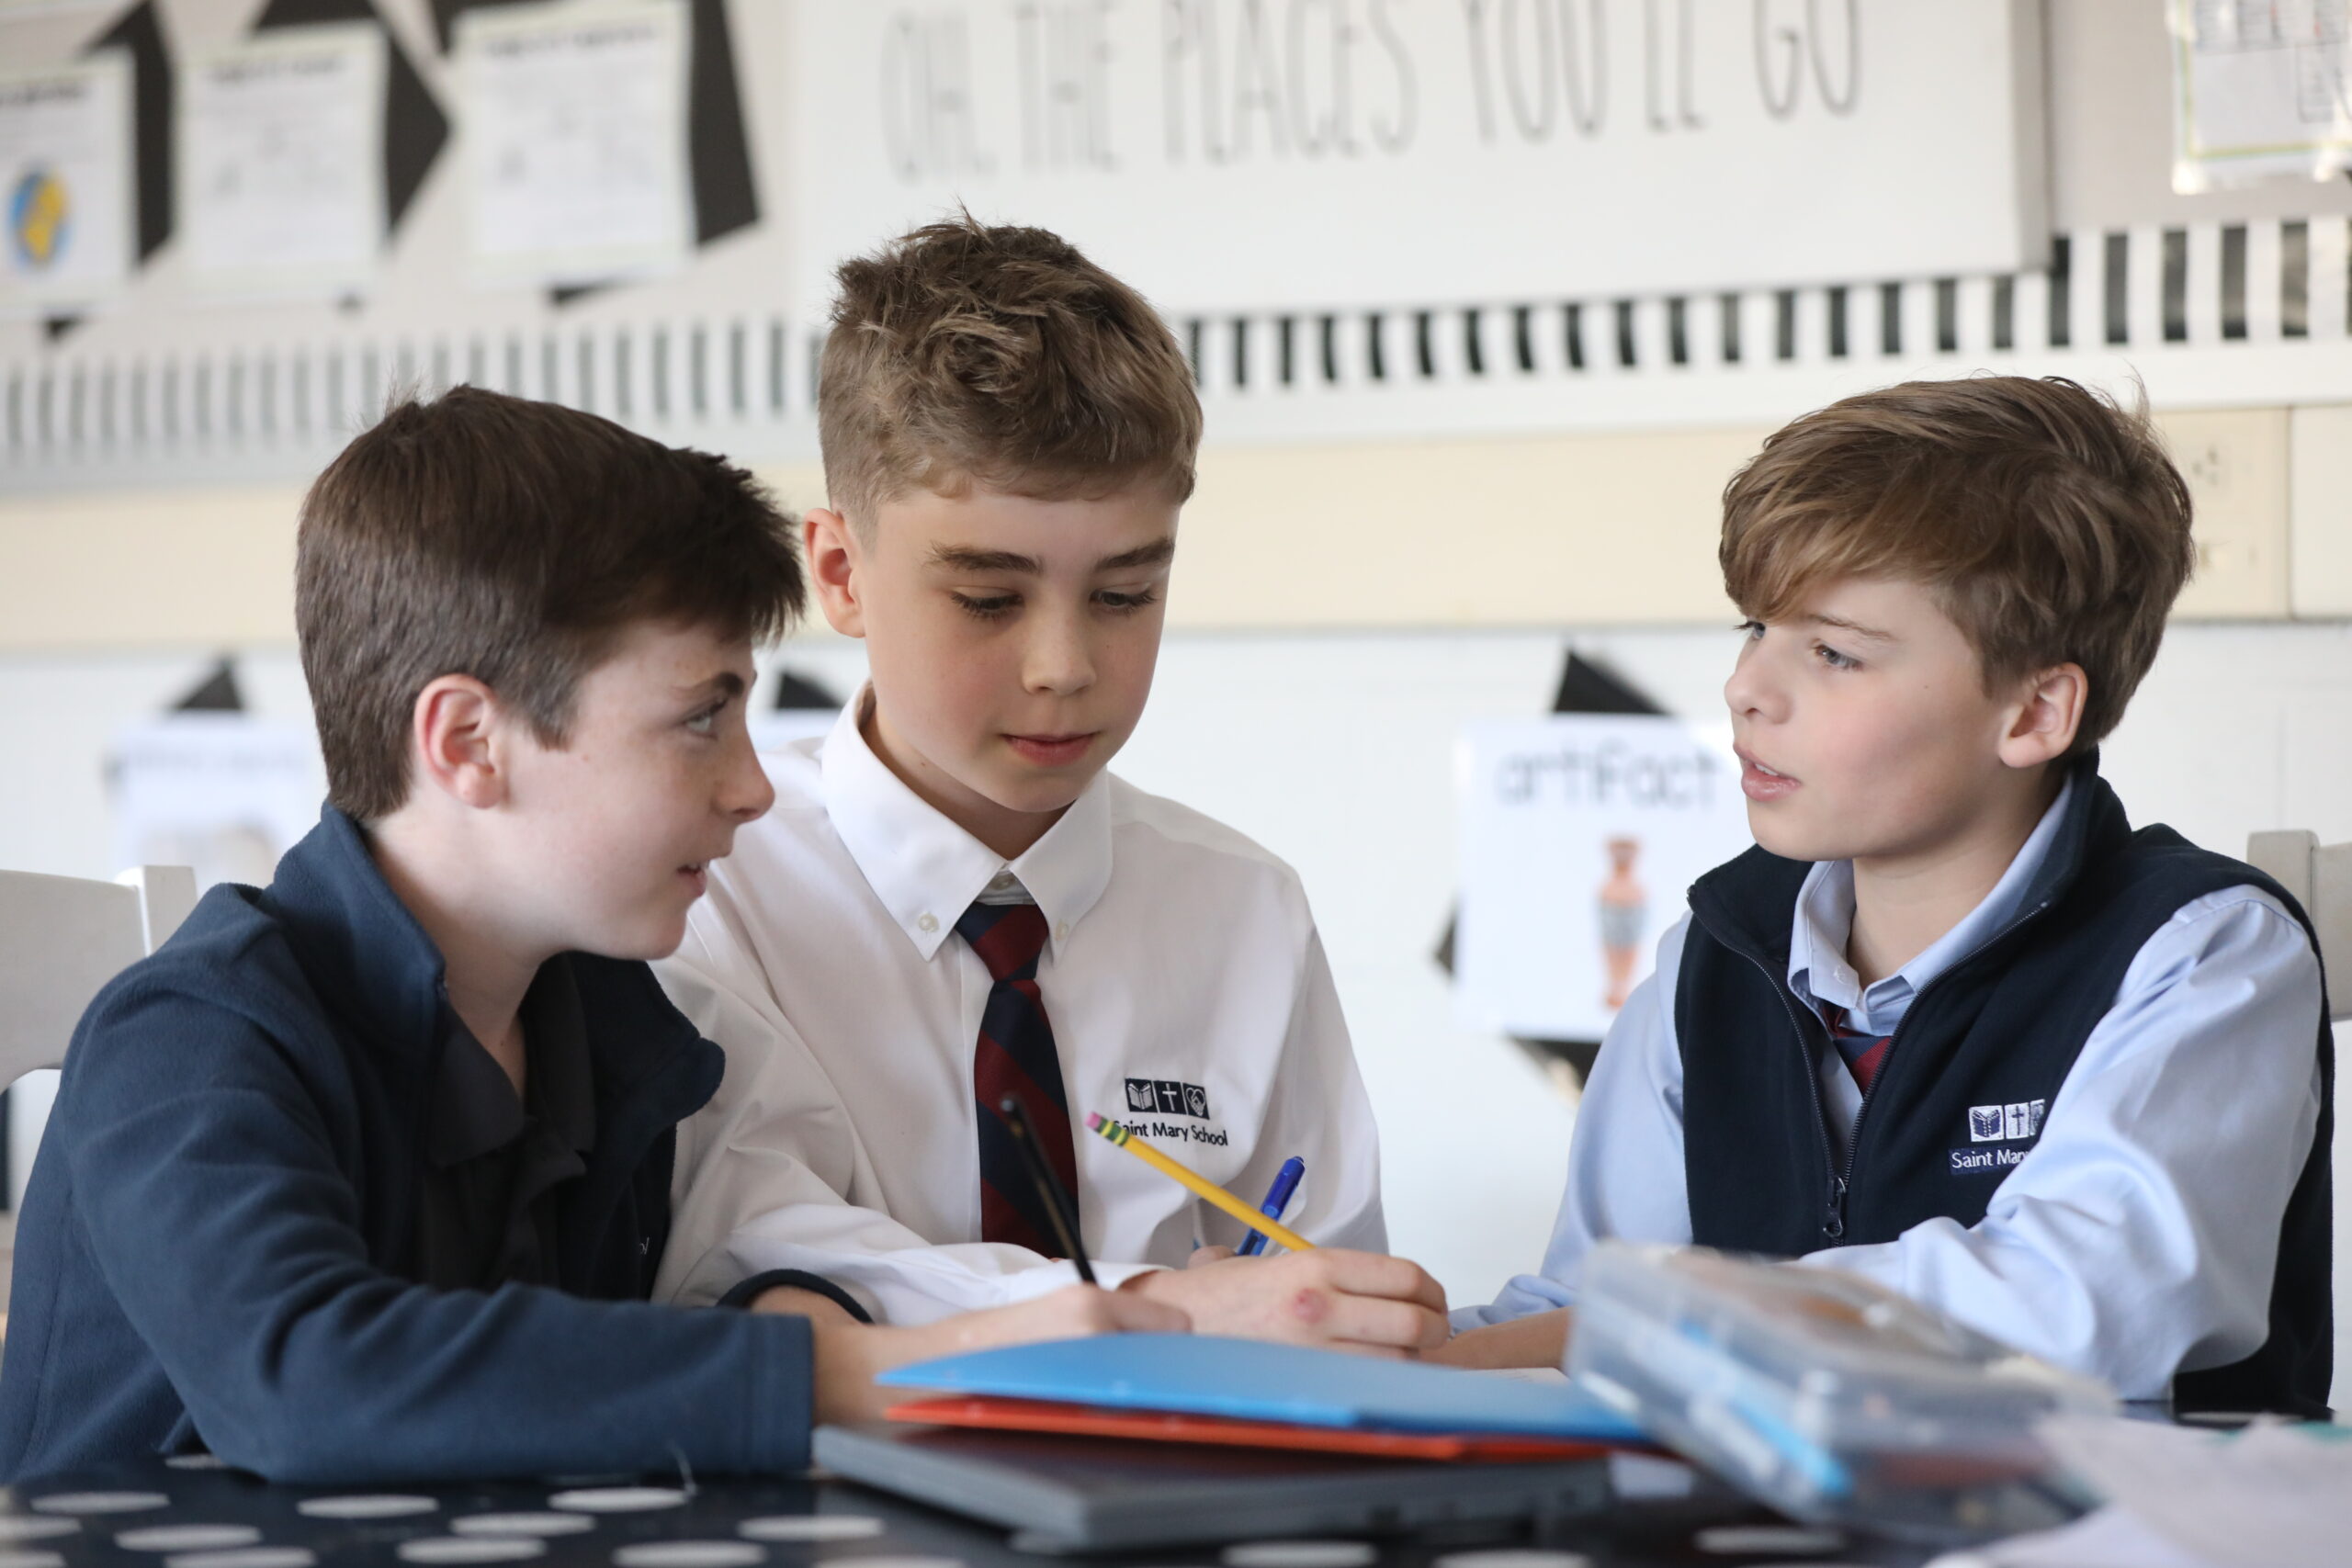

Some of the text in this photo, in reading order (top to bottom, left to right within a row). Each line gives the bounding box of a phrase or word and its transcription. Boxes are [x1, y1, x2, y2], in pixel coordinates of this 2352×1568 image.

[1005, 0, 1121, 177] THE
[1159, 0, 1419, 168] PLACES
[1751, 0, 1864, 123] GO
[1114, 1120, 1228, 1146] aint Mary School
[1951, 1148, 2029, 1168] Saint Mar
